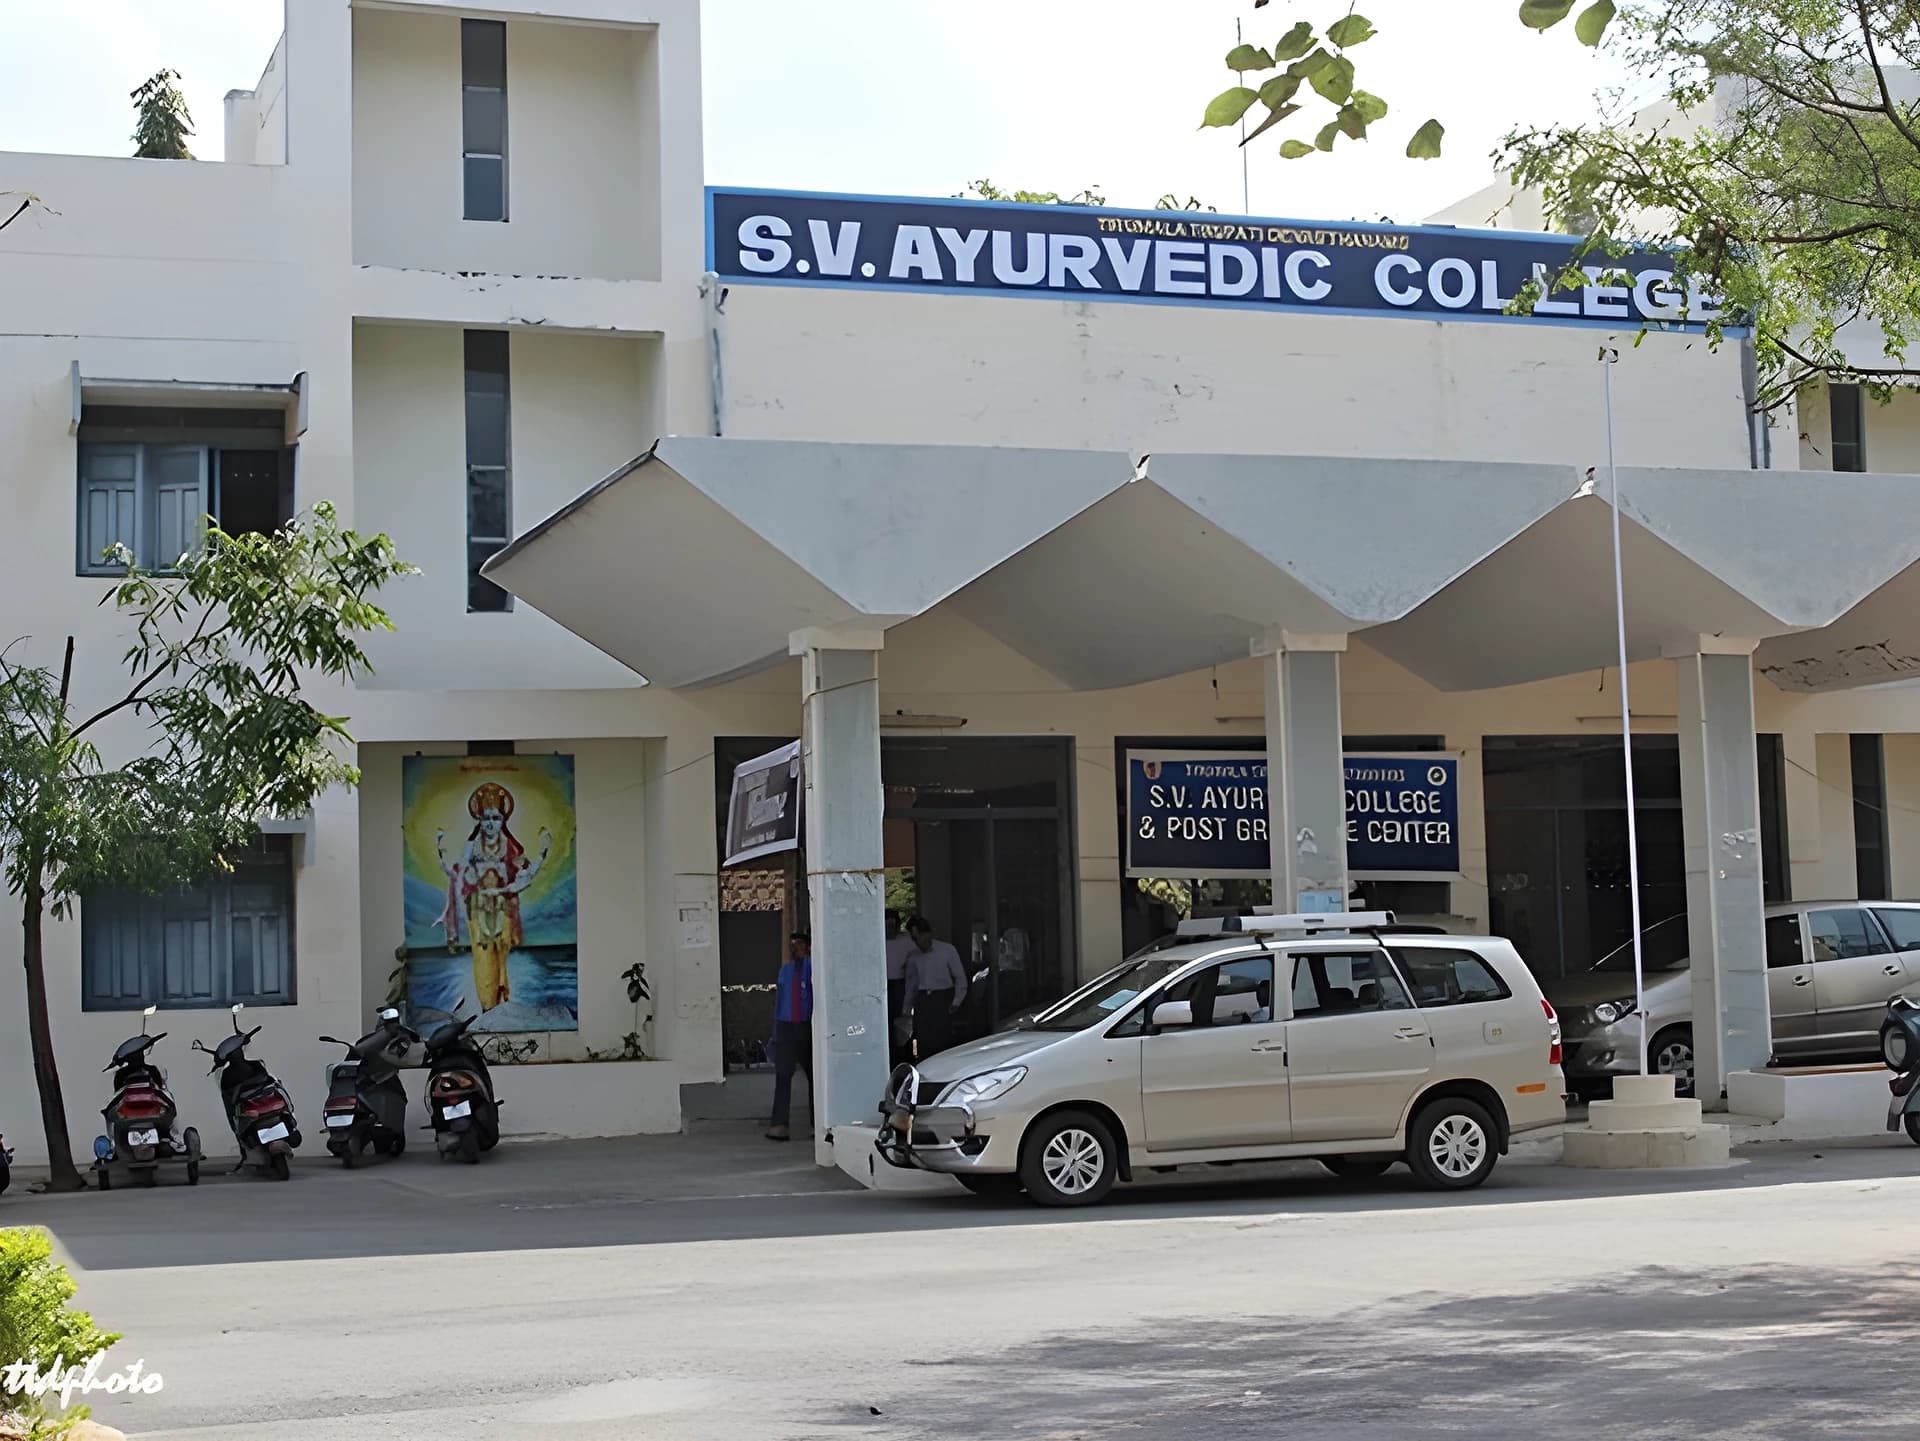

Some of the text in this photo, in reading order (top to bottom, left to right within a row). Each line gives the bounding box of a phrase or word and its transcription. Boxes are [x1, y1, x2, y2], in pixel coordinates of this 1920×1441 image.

[737, 214, 877, 279] S.V.
[888, 224, 1333, 302] AYURVEDIC
[1150, 784, 1193, 809] S.V.
[1138, 815, 1156, 840] &
[1167, 816, 1228, 841] POST
